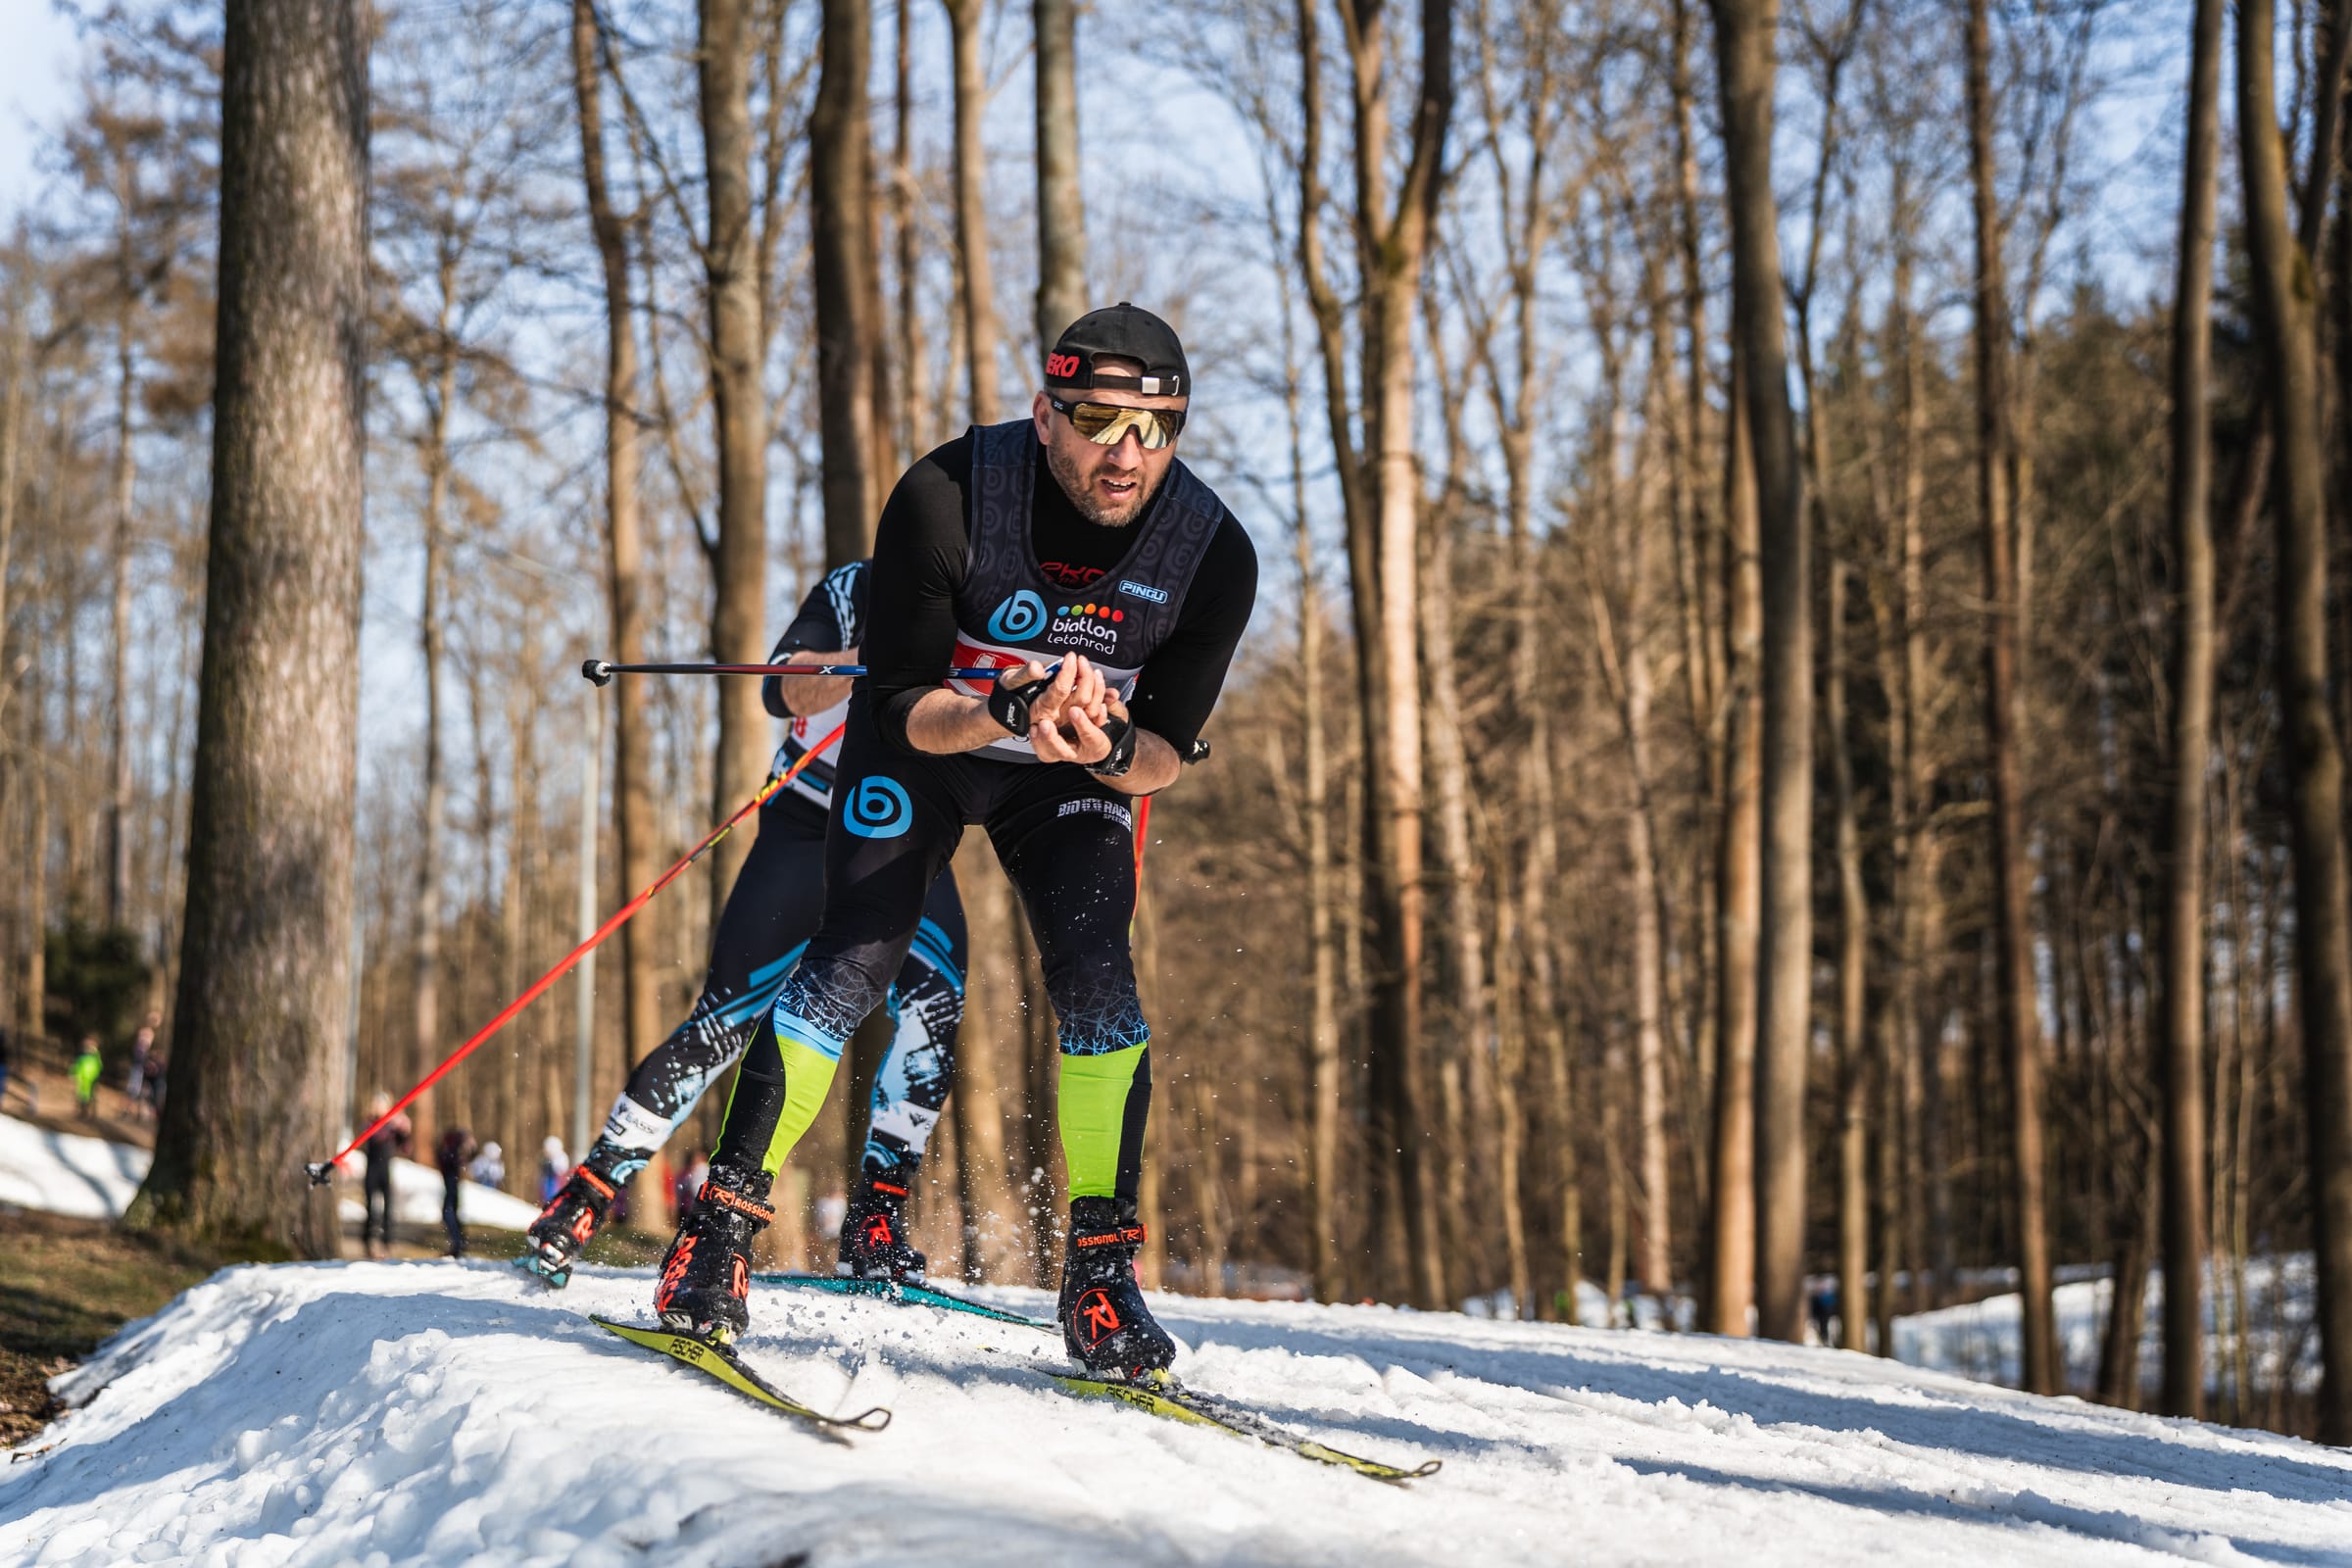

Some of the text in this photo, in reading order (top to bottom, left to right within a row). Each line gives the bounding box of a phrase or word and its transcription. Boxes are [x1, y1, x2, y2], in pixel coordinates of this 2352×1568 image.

[1122, 582, 1164, 601] PINGU
[1052, 616, 1117, 643] biatlon
[668, 1338, 705, 1364] FISCHER
